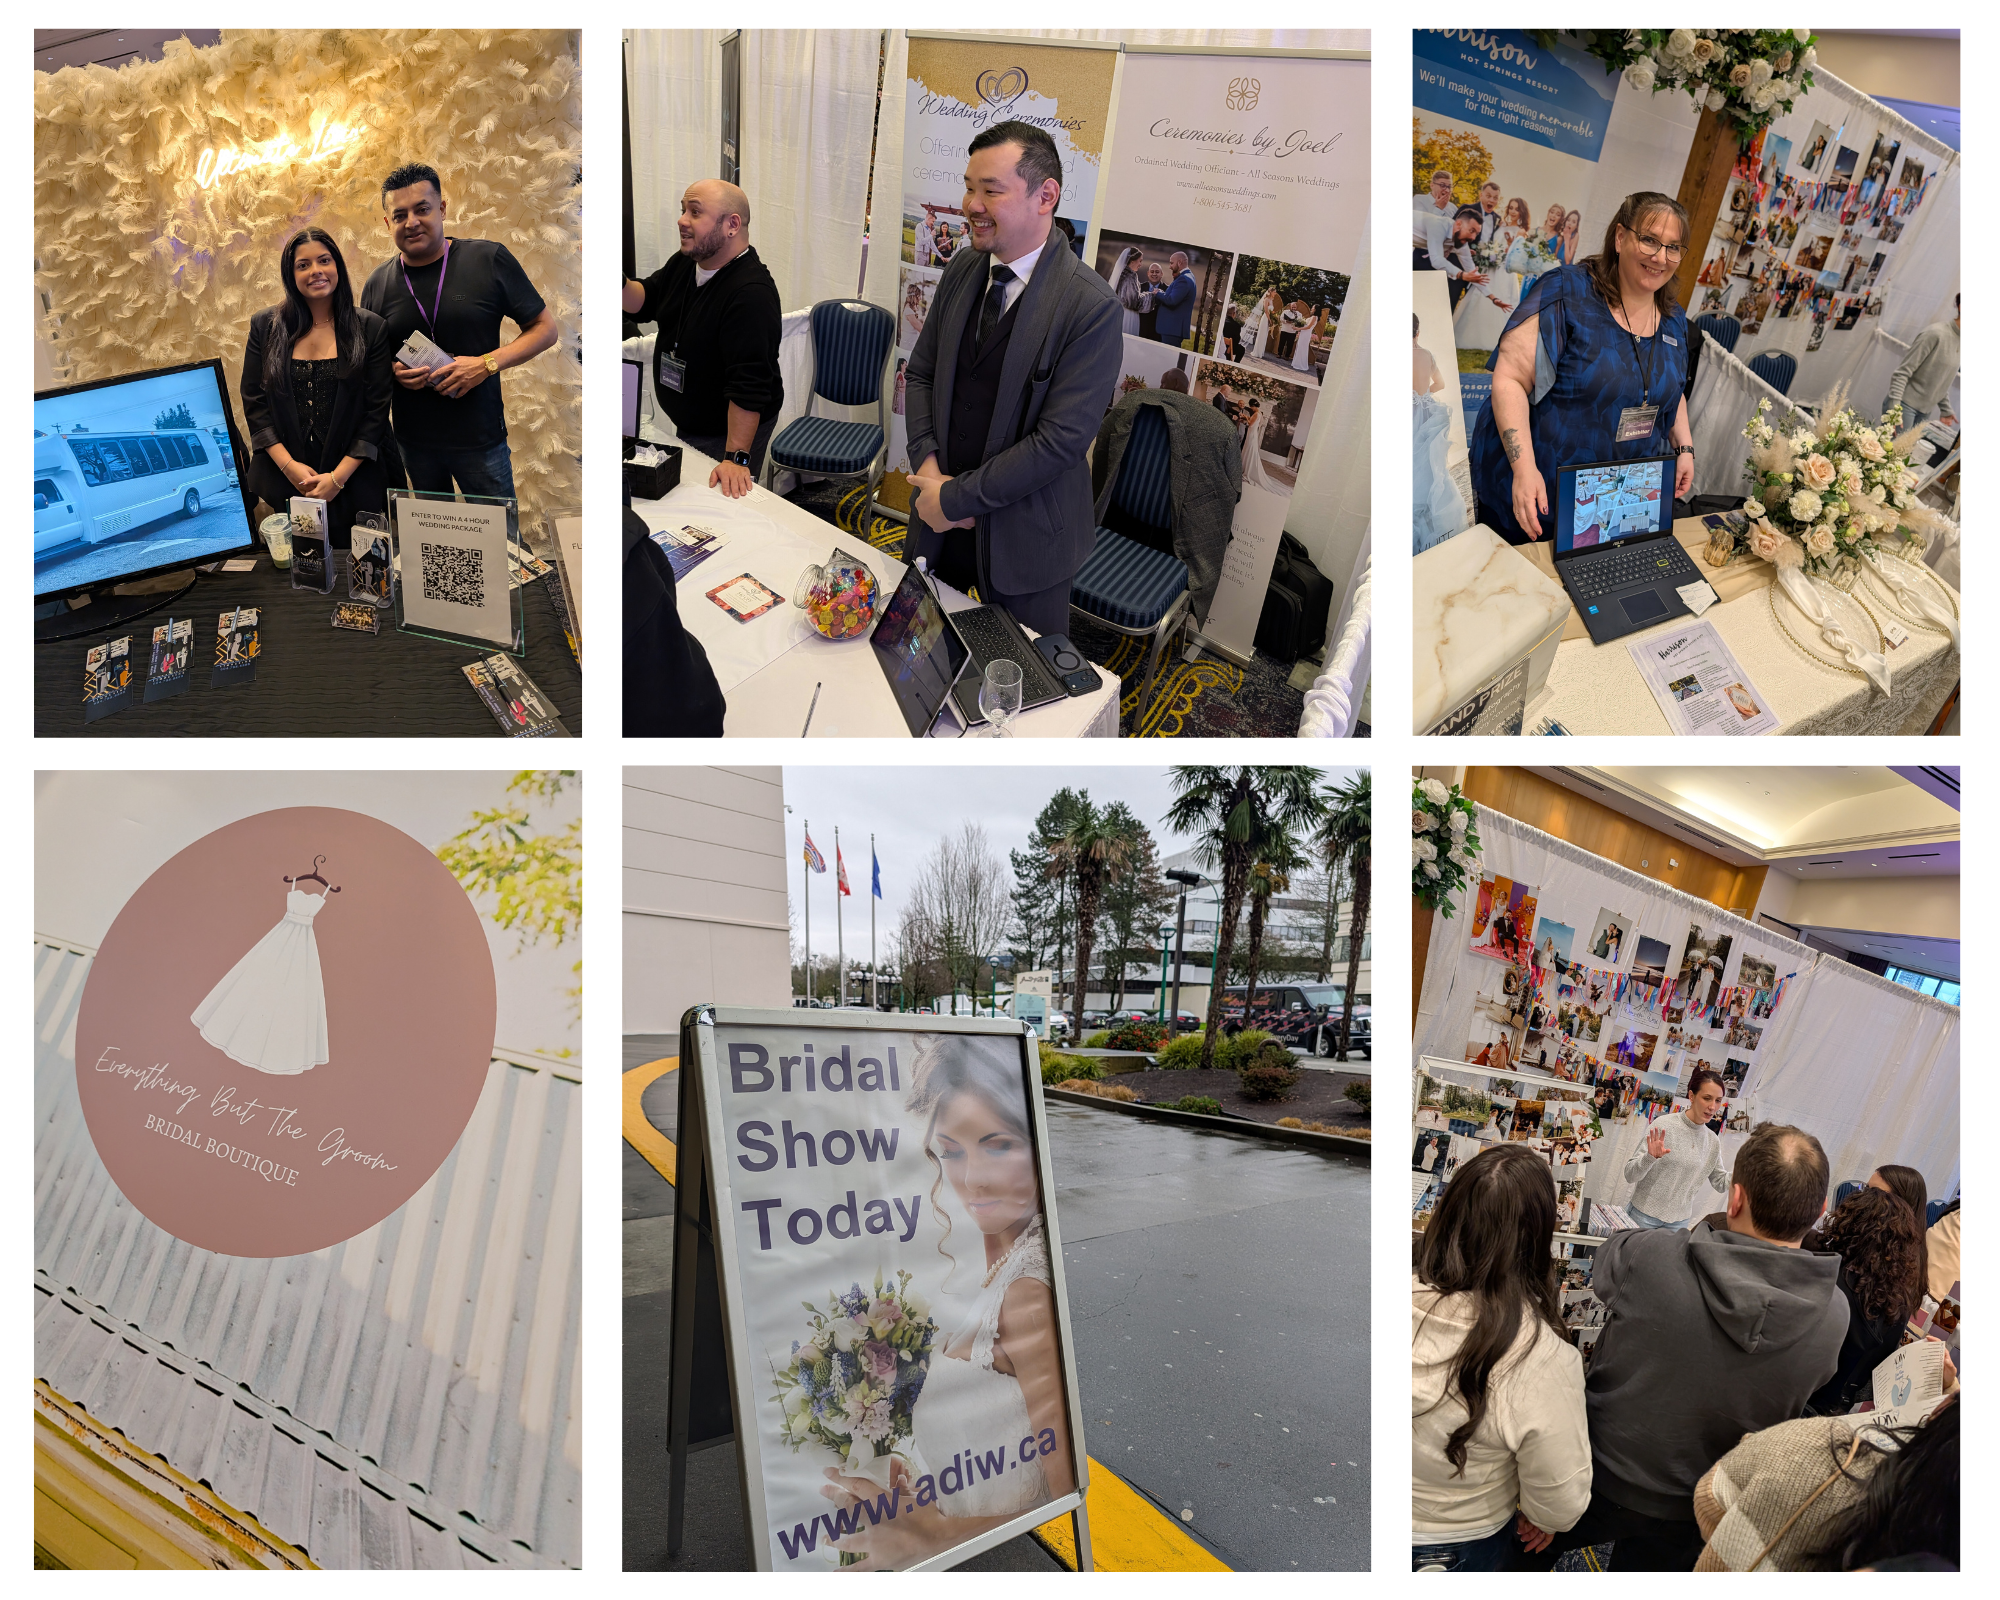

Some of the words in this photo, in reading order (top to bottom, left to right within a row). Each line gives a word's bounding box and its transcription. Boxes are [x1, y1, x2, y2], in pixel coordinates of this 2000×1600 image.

[1461, 53, 1479, 65] HOT
[1484, 62, 1523, 81] SPRINGS
[1526, 78, 1559, 94] RESORT
[918, 94, 988, 128] Wedding
[1420, 69, 1445, 87] We'll
[1448, 81, 1475, 97] make
[1478, 91, 1499, 105] your
[1501, 98, 1538, 120] wedding
[1539, 112, 1594, 138] memorable
[1464, 99, 1477, 112] for
[1480, 104, 1496, 117] the
[1498, 110, 1519, 126] right
[1521, 119, 1557, 137] reasons!
[1149, 118, 1246, 145] Ceremonies
[1252, 126, 1276, 155] by
[1274, 129, 1343, 158] Joel
[913, 166, 965, 184] ceremo
[1134, 155, 1168, 167] Ordained
[1170, 159, 1203, 173] Wedding
[1204, 163, 1239, 176] Officiant
[1247, 169, 1260, 179] All
[1262, 171, 1294, 183] Seasons
[1296, 175, 1340, 191] Weddings
[1176, 180, 1277, 200] www.allseasonsweddings.com
[411, 511, 431, 519] ENTER
[469, 517, 490, 525] HOUR
[418, 521, 450, 530] WEDDING
[451, 524, 483, 534] PACKAGE
[1240, 528, 1265, 543] always
[1658, 636, 1688, 660] Harrison
[1479, 664, 1523, 707] PRIZE
[728, 1043, 900, 1093] Bridal
[95, 1046, 201, 1115] Everything
[210, 1085, 264, 1125] But
[267, 1107, 307, 1140] The
[317, 1127, 398, 1171] Groom
[144, 1114, 202, 1149] BRIDAL
[204, 1137, 300, 1187] BOUTIQUE
[737, 1120, 900, 1172] Show
[741, 1190, 922, 1250] Today
[777, 1427, 1057, 1560] www.adiw.ca
